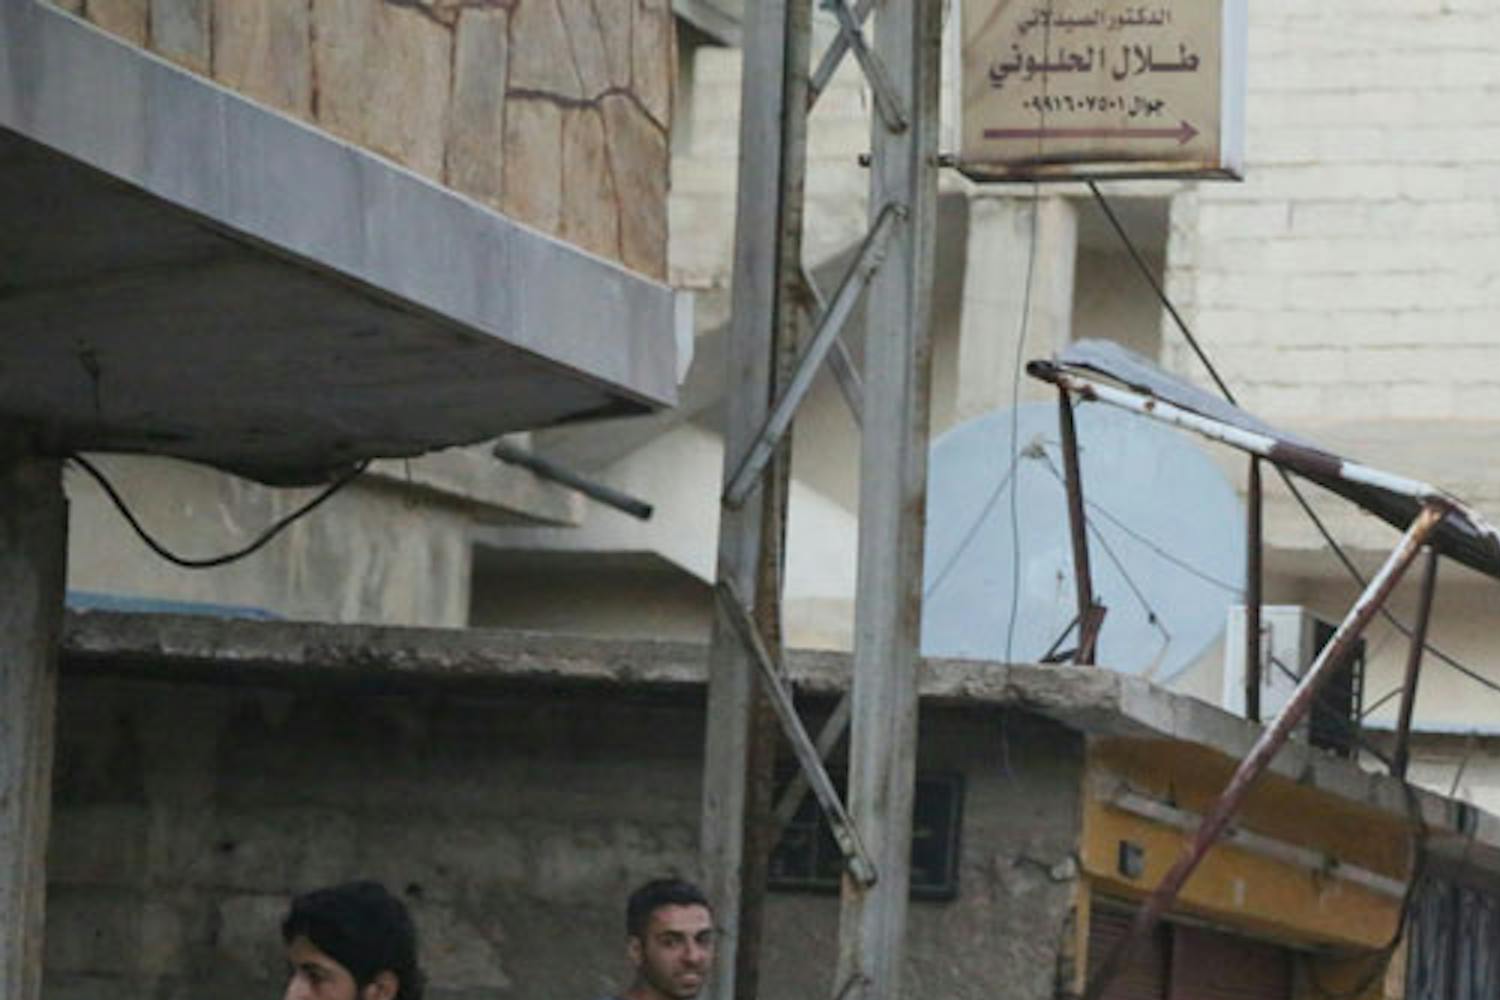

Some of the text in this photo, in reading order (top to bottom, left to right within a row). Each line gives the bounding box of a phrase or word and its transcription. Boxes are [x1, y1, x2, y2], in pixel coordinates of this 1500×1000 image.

[1017, 7, 1171, 35] الدكتور الصيدلاني
[1112, 43, 1200, 81] طلال
[1129, 96, 1166, 117] جوال
